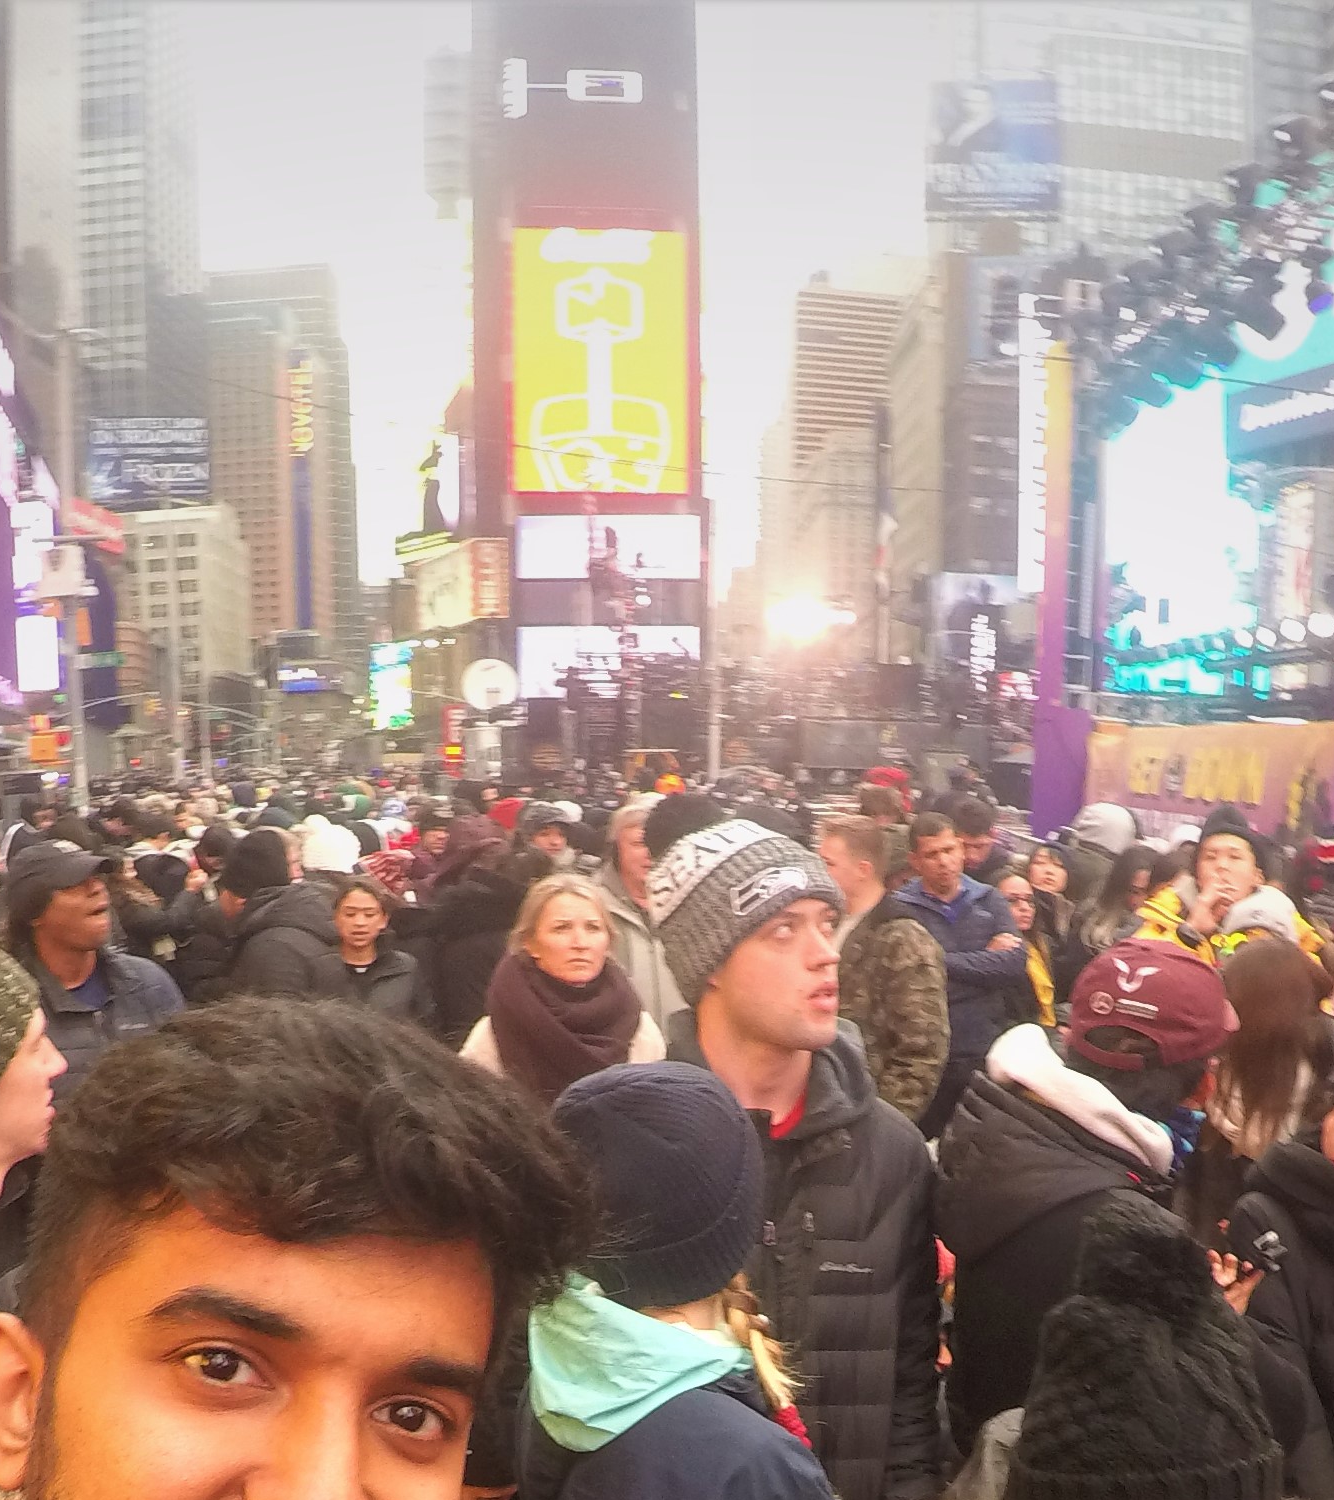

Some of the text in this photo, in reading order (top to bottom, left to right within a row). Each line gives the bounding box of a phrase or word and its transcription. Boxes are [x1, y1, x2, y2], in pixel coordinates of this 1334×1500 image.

[287, 360, 314, 457] NOVOTEL
[1128, 747, 1265, 807] GET DOWN
